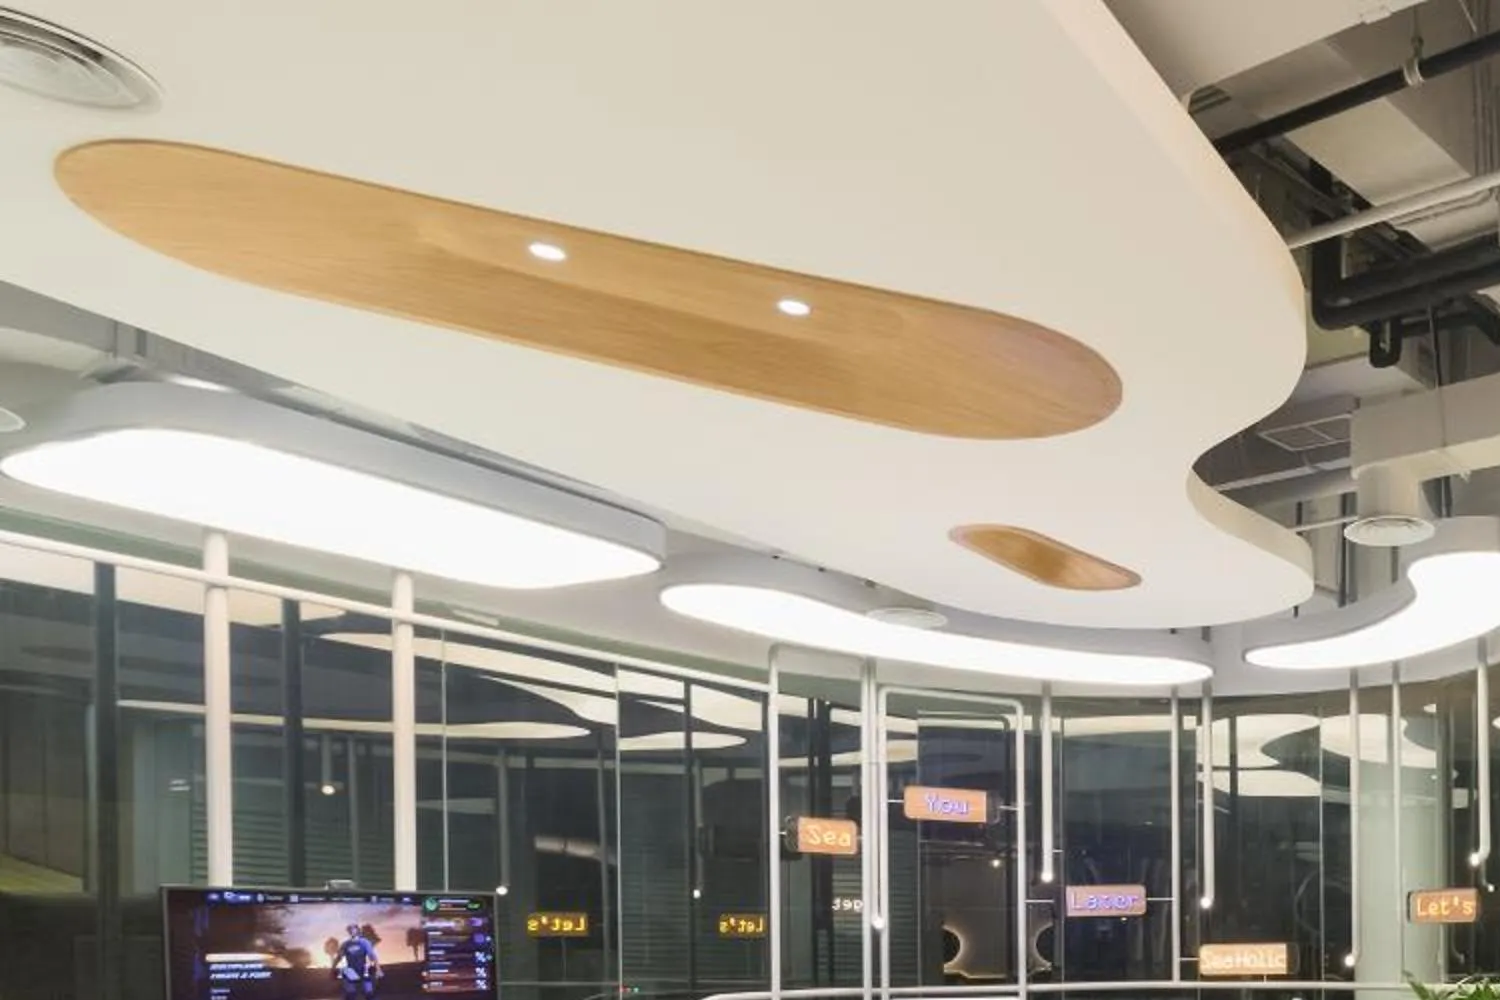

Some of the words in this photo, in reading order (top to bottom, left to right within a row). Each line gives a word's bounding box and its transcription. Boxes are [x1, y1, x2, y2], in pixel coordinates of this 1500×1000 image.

[926, 794, 969, 816] You
[805, 825, 851, 847] Sea
[1417, 896, 1474, 917] Let's
